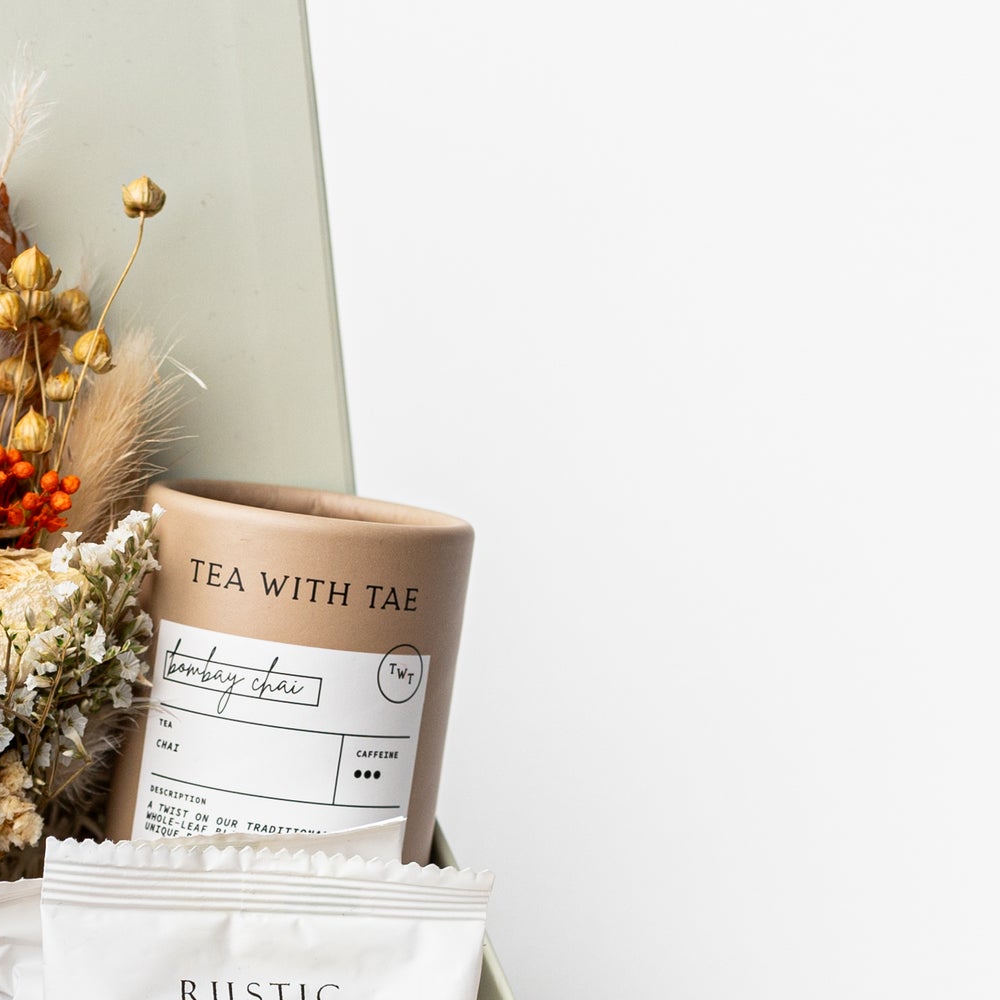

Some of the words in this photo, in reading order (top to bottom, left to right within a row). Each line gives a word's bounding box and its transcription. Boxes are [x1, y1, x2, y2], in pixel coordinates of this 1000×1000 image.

[190, 558, 245, 592] TEA
[260, 572, 351, 606] WITH
[366, 585, 420, 612] TAE
[167, 638, 245, 714] bombay
[252, 656, 304, 698] chai
[389, 663, 415, 685] TWT
[159, 718, 173, 729] TEA
[156, 739, 180, 752] CHAI
[356, 750, 399, 759] CAFFEINE
[150, 785, 207, 805] DESCRIPTION
[146, 811, 208, 833] WHOLE-LEAF
[147, 801, 153, 809] A
[159, 803, 189, 818] TWIST
[195, 813, 210, 823] ON
[216, 817, 239, 828] OUR
